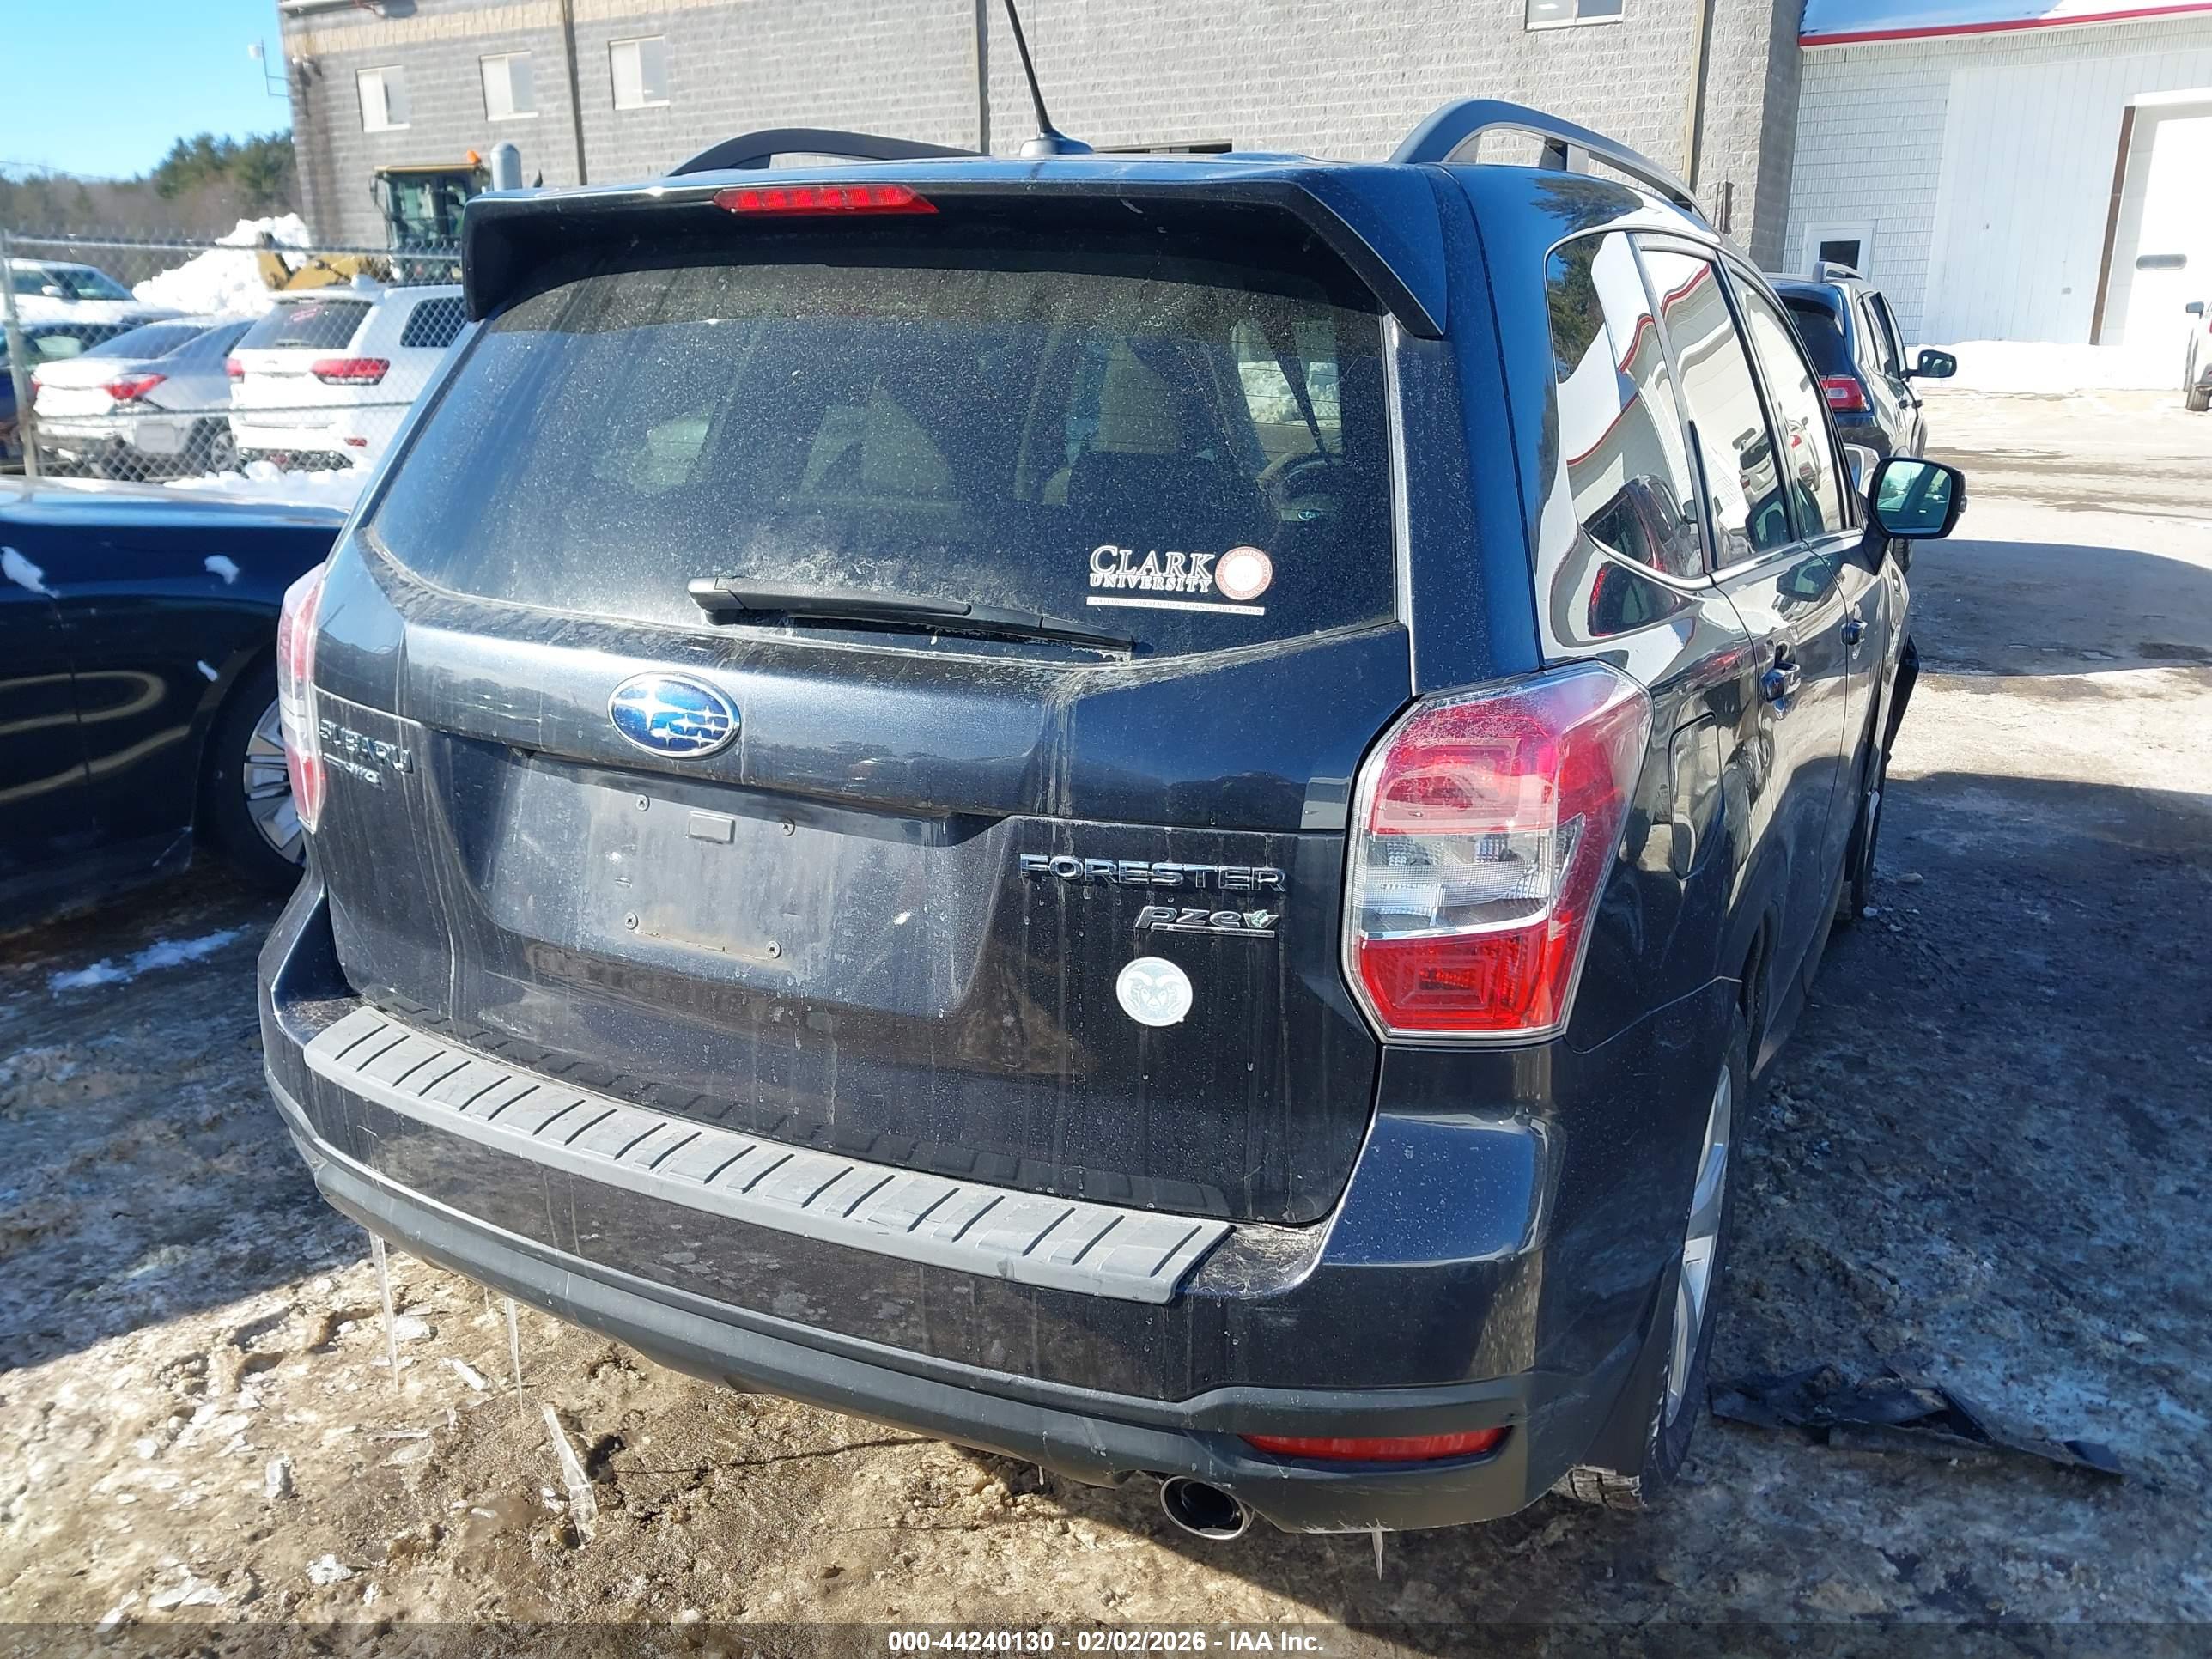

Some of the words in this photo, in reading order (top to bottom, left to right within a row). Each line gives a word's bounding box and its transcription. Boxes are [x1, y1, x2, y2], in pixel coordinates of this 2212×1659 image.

[1090, 545, 1215, 579] CLARK
[1090, 574, 1212, 592] UNIVERSITY
[319, 718, 414, 774] SUBARU
[1020, 854, 1286, 892] FORESTER
